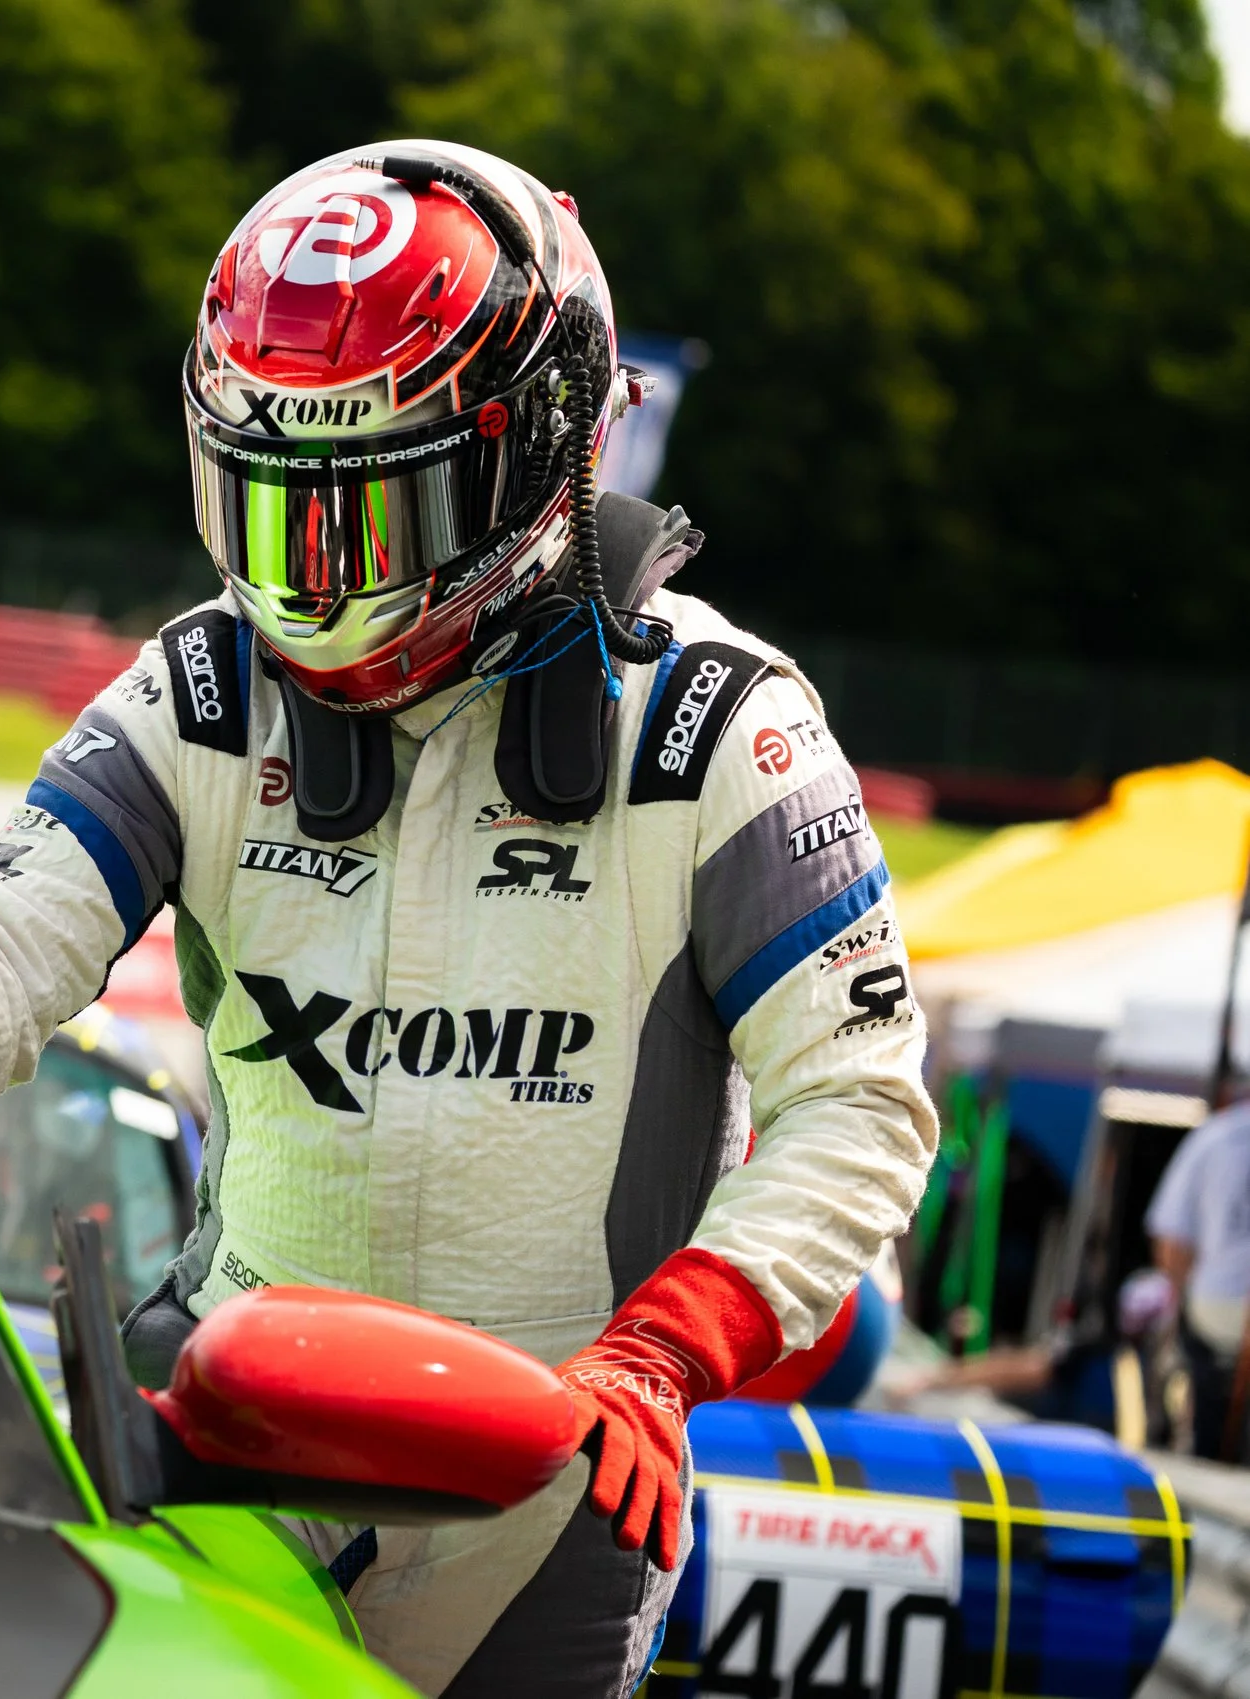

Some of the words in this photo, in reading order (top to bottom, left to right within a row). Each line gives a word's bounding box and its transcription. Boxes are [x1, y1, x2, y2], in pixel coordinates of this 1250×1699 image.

[236, 388, 372, 437] XCOMP
[201, 431, 323, 470] PERFORMANCE
[331, 428, 474, 469] MOTORSPORT
[485, 569, 538, 616] Mikey
[178, 626, 224, 723] sparco
[659, 658, 732, 777] sparco
[239, 839, 378, 897] TITAN7
[475, 887, 585, 902] SUSPENSION
[477, 838, 592, 894] SPL
[220, 969, 595, 1115] XCOMP
[510, 1080, 595, 1105] TIRES
[736, 1509, 816, 1547] TIRE
[826, 1517, 939, 1578] RACK
[698, 1578, 962, 1699] 440
